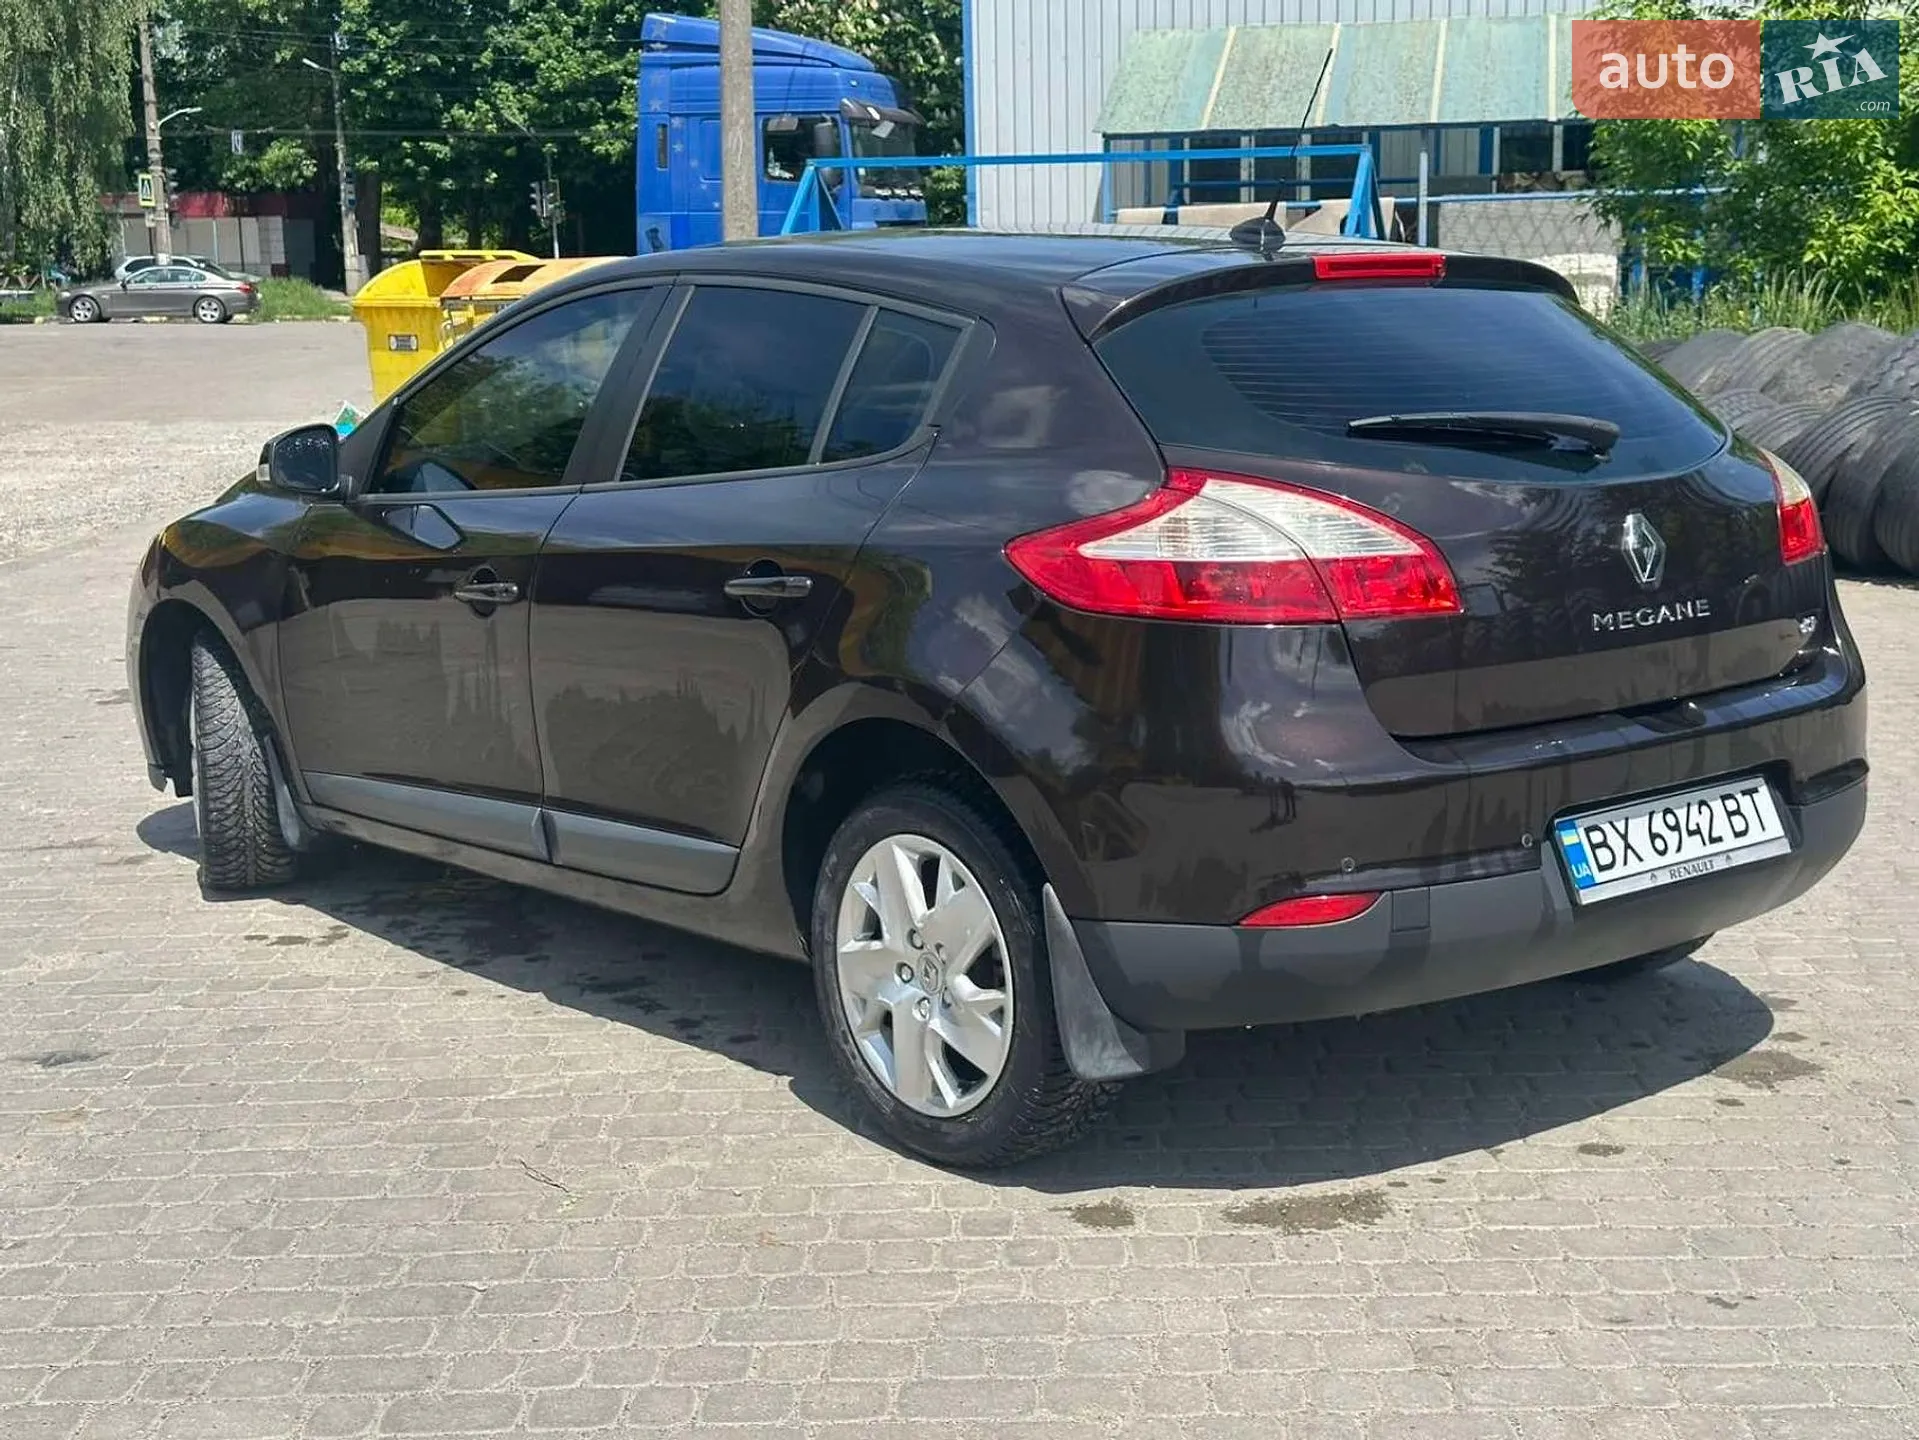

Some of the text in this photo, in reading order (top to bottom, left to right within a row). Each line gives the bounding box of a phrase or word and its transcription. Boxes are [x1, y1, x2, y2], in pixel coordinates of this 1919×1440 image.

[1592, 599, 1711, 631] MEGANE
[1583, 787, 1767, 873] BX 6942 BT
[1571, 862, 1593, 879] UA
[1669, 859, 1715, 880] RENAULT
